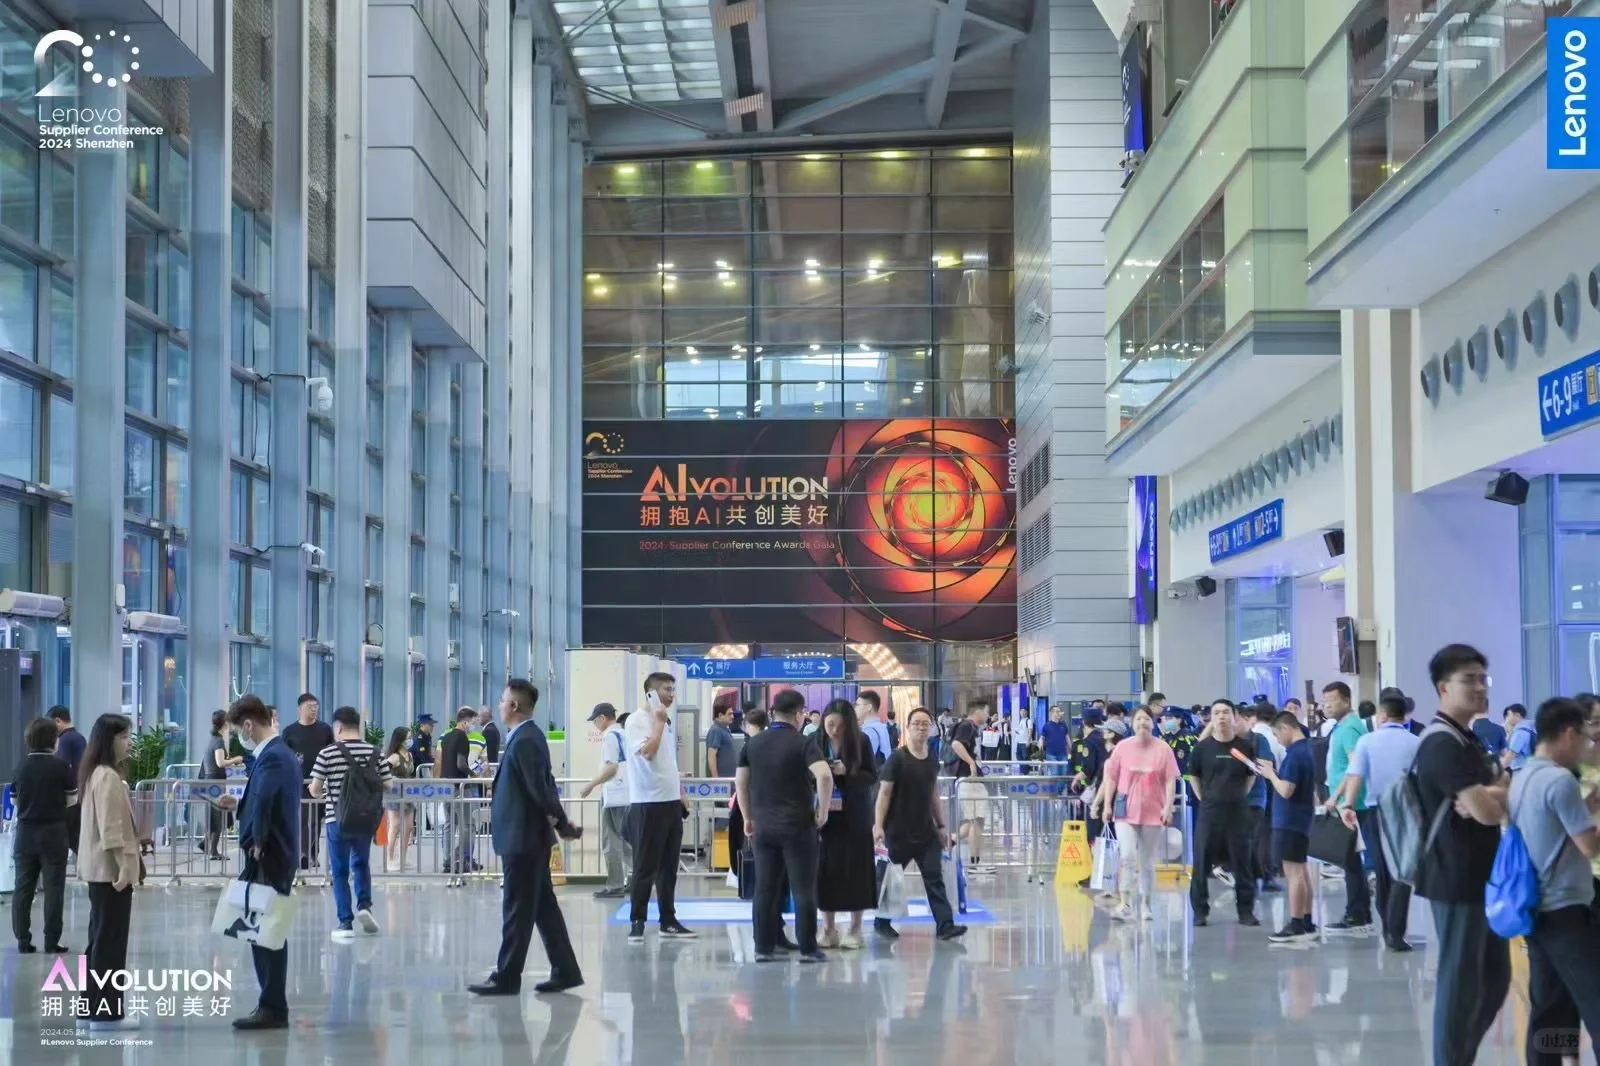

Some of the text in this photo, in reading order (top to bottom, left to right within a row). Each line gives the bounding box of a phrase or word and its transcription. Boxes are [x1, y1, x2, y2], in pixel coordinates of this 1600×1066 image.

[1552, 375, 1572, 418] 6-9
[1006, 438, 1016, 491] Lenovo
[640, 463, 828, 501] AIVOLUTION
[640, 504, 828, 526] 拥抱AI共创美好
[639, 541, 663, 549] 2024
[670, 541, 709, 551] Supplier
[712, 540, 771, 549] Conference
[774, 540, 811, 549] Awards
[704, 661, 713, 675] 6
[783, 662, 814, 670] 服务大厅
